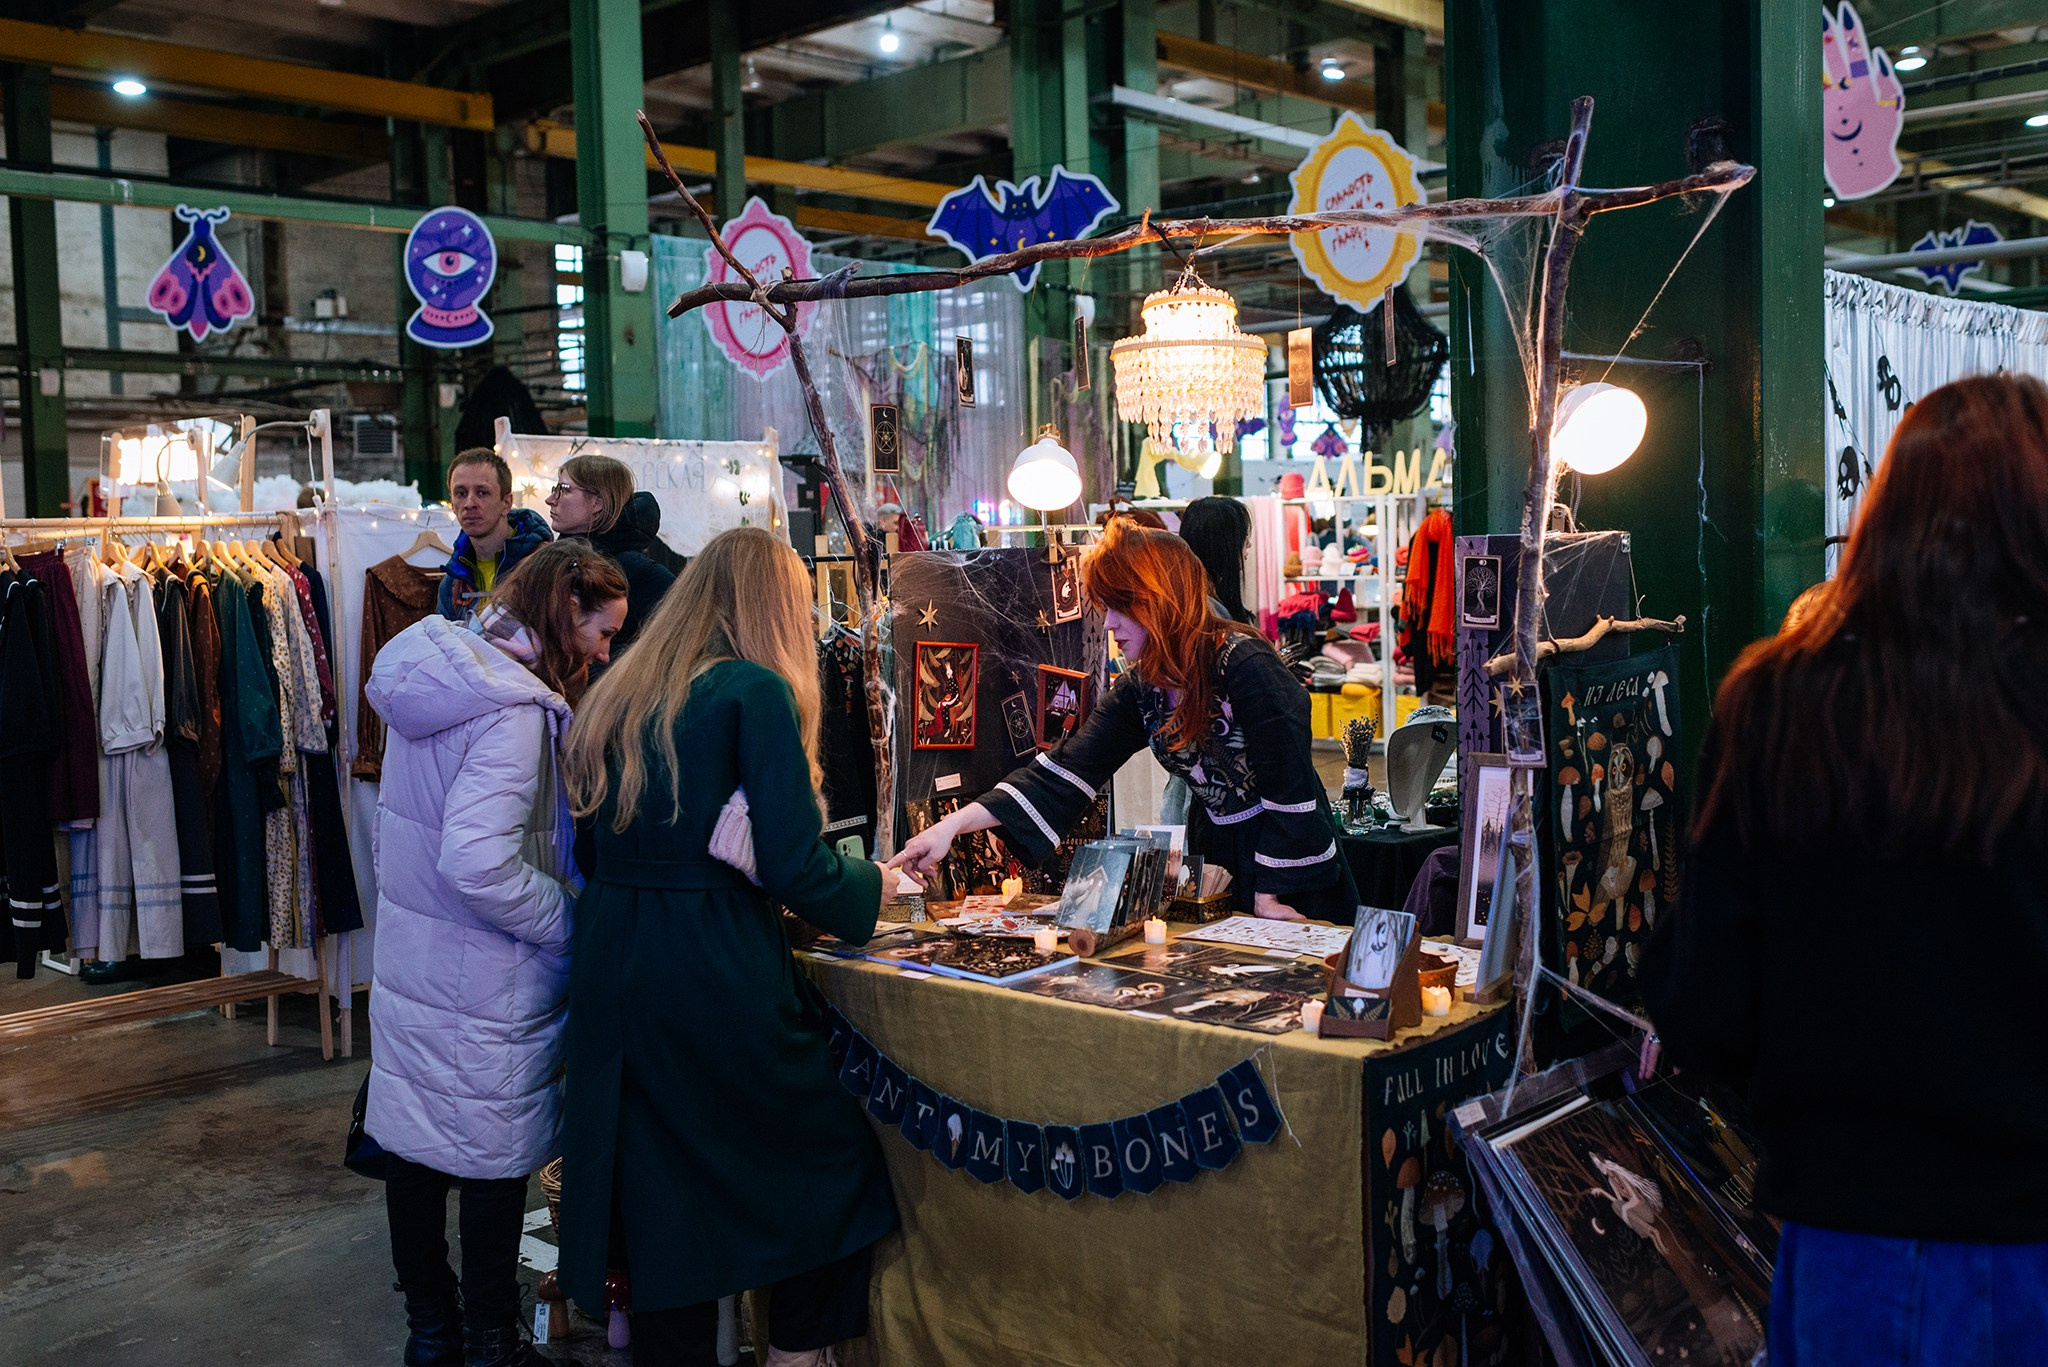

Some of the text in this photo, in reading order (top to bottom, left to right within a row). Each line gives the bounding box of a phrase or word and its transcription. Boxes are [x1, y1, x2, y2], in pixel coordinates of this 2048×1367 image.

[1583, 676, 1640, 708] ИЗ ЛЕСА
[1383, 1031, 1509, 1106] FALL IN LOVE
[970, 1130, 1037, 1174] MY
[1092, 1087, 1260, 1179] BONES
